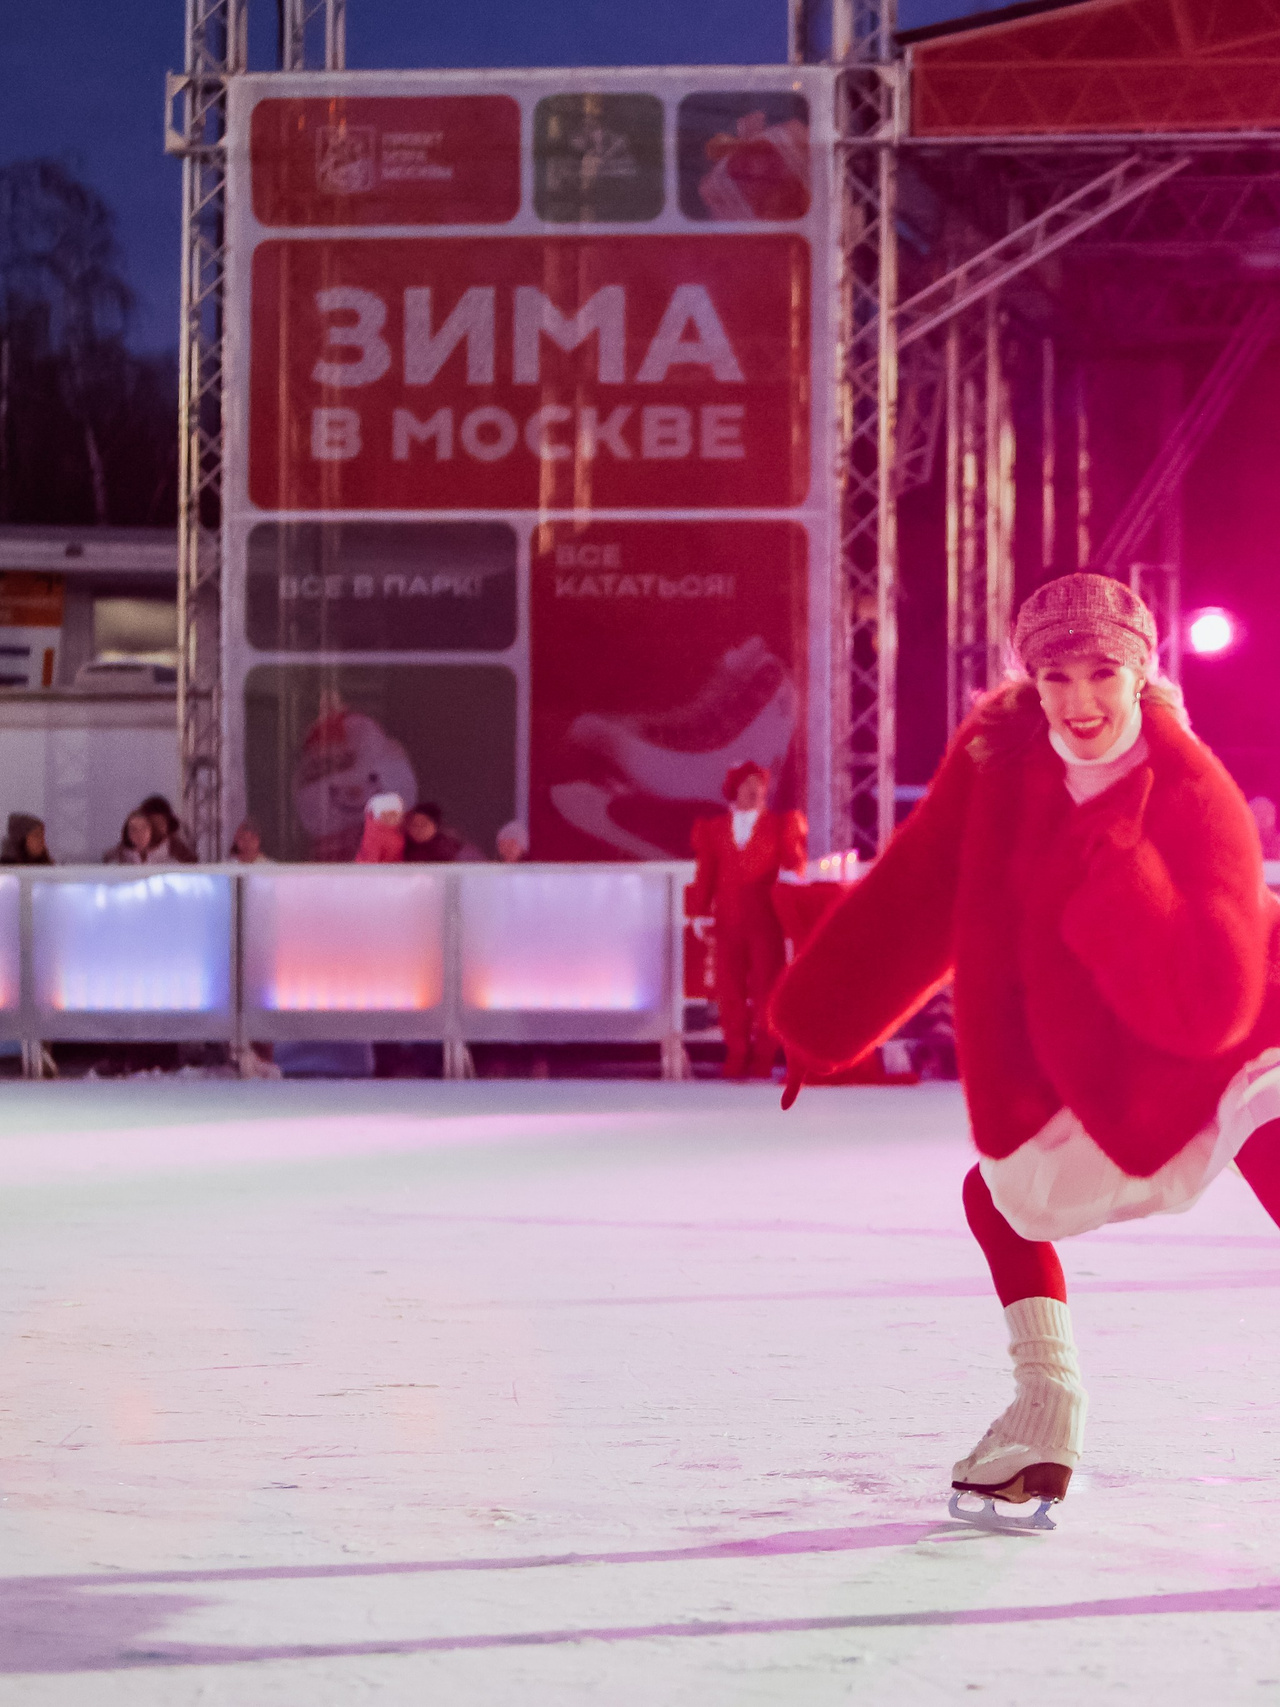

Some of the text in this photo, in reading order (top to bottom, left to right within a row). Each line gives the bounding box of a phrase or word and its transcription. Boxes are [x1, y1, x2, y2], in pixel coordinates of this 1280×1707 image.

[311, 284, 745, 387] ЗИМА
[310, 405, 746, 461] В МОСКВЕ
